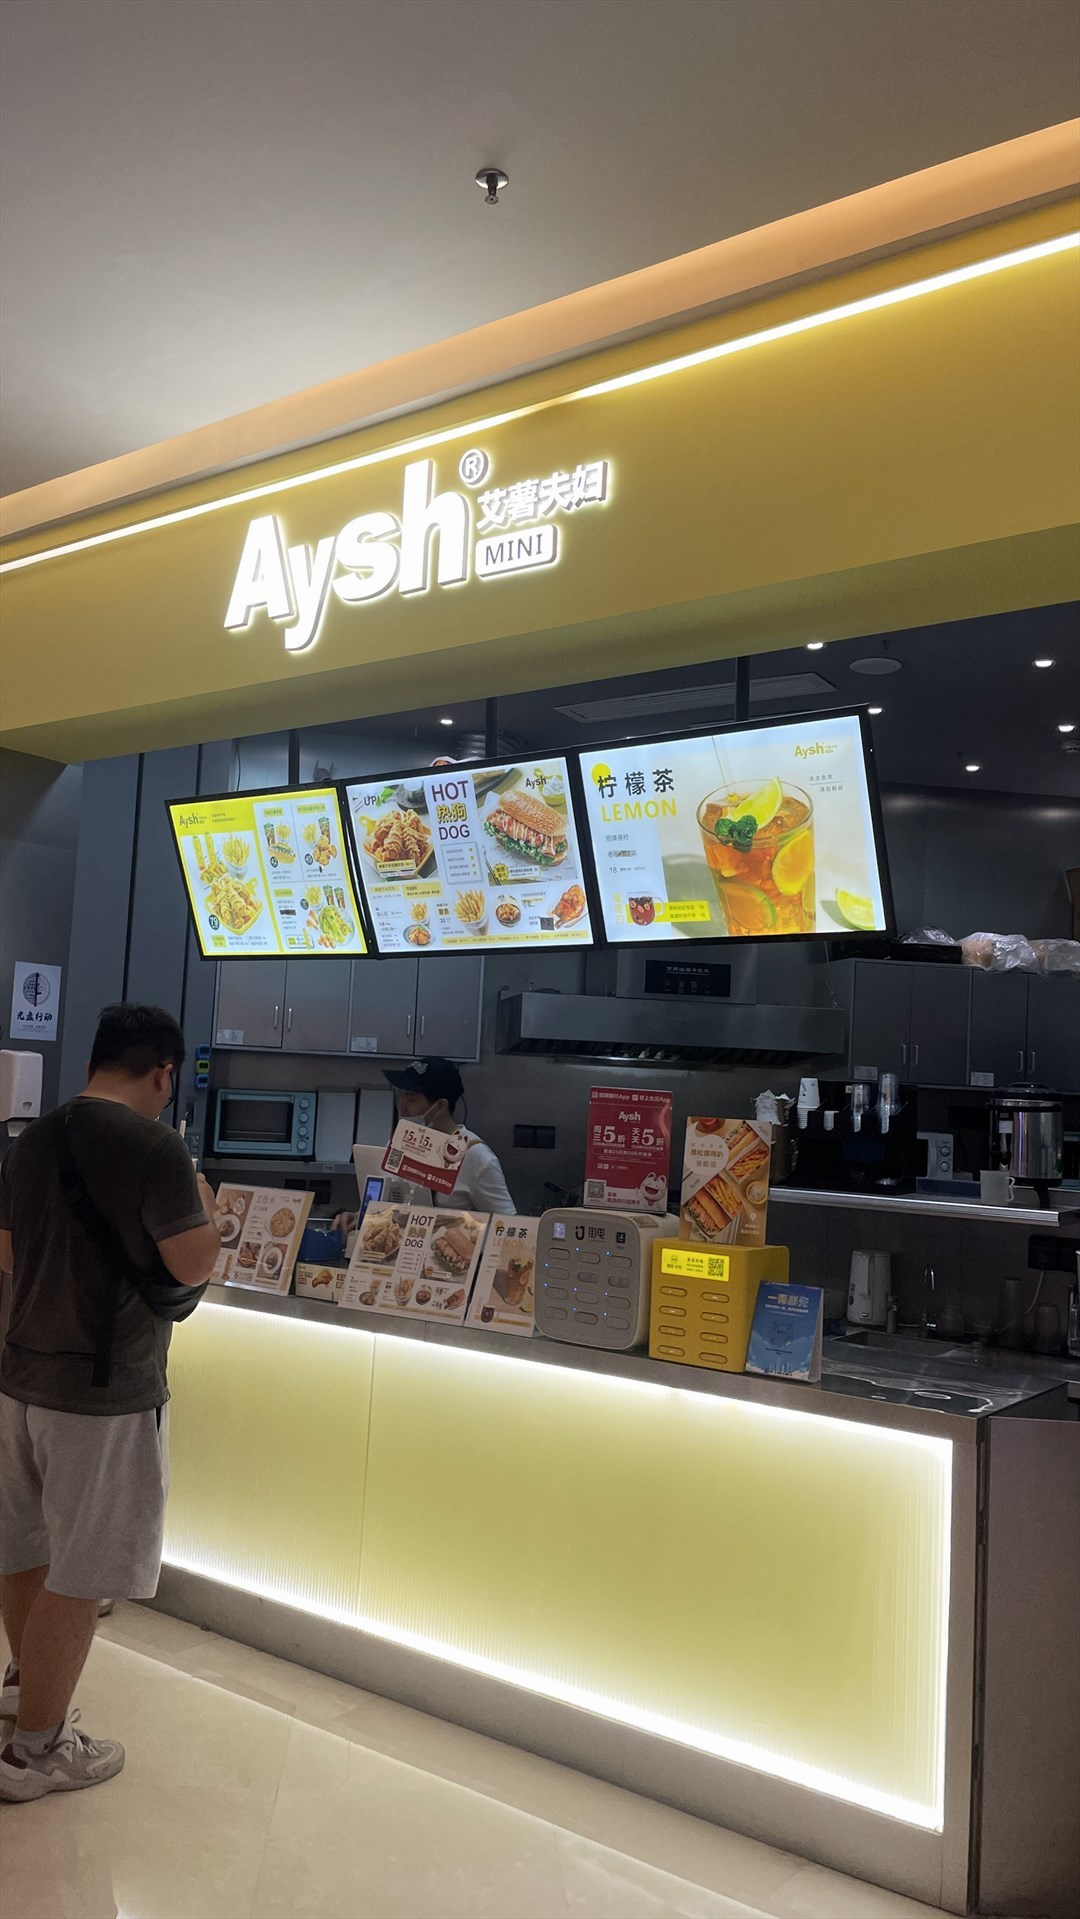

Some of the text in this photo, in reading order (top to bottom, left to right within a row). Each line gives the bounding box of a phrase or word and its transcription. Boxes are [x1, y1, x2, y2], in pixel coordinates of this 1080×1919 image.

[476, 461, 609, 532] 艾薯夫妇
[224, 459, 469, 651] Aysh
[485, 533, 543, 567] MINI
[794, 742, 825, 759] Aysh
[432, 780, 469, 802] HOT
[526, 776, 546, 789] Aysh
[597, 768, 675, 799] 柠檬茶
[436, 802, 468, 824] 热狗
[601, 798, 678, 823] LEMON
[179, 812, 199, 829] Aysh
[438, 823, 471, 841] DOG
[16, 1010, 53, 1022] 光盘行动
[618, 1110, 641, 1123] Aysh
[410, 1214, 434, 1227] HOT
[495, 1226, 529, 1239] 柠檬茶
[404, 1238, 424, 1248] DOG
